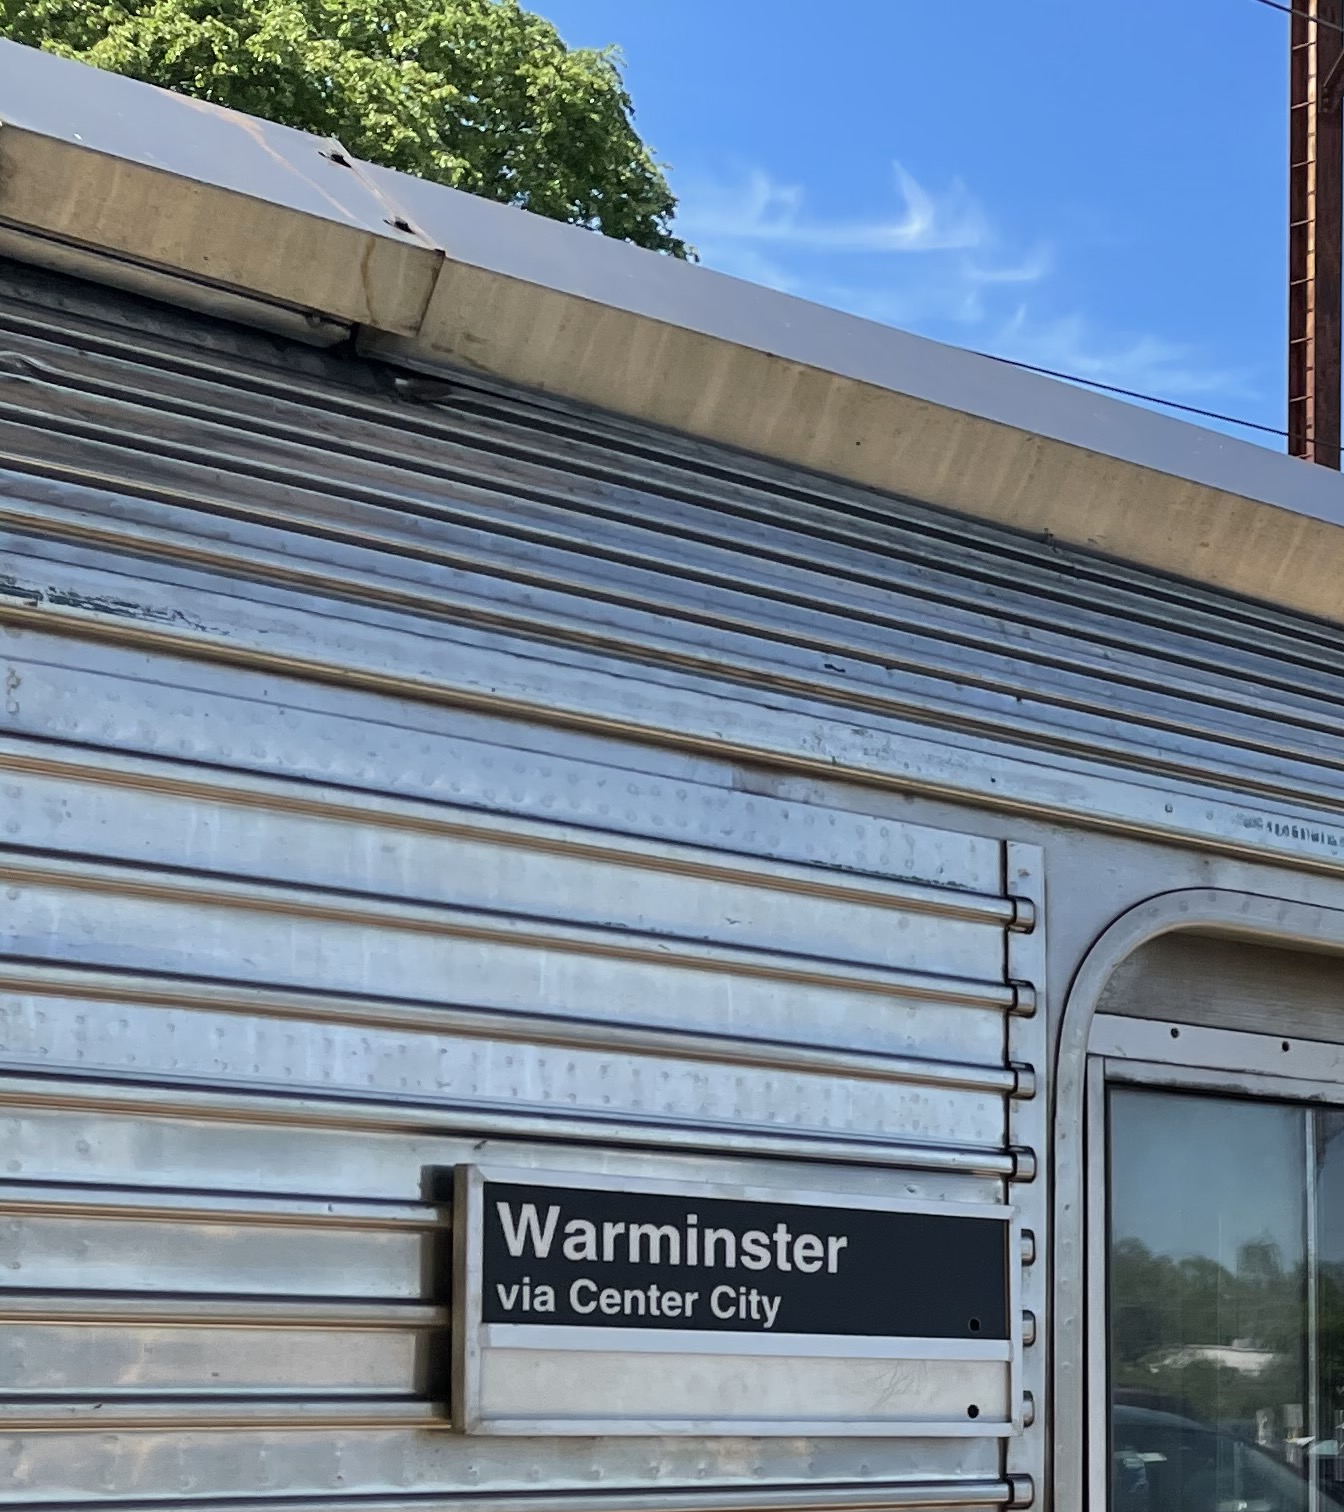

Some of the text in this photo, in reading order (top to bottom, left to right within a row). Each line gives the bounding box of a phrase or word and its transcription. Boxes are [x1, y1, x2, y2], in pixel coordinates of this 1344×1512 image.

[496, 1201, 848, 1275] Warminster
[496, 1276, 783, 1330] via Center City
